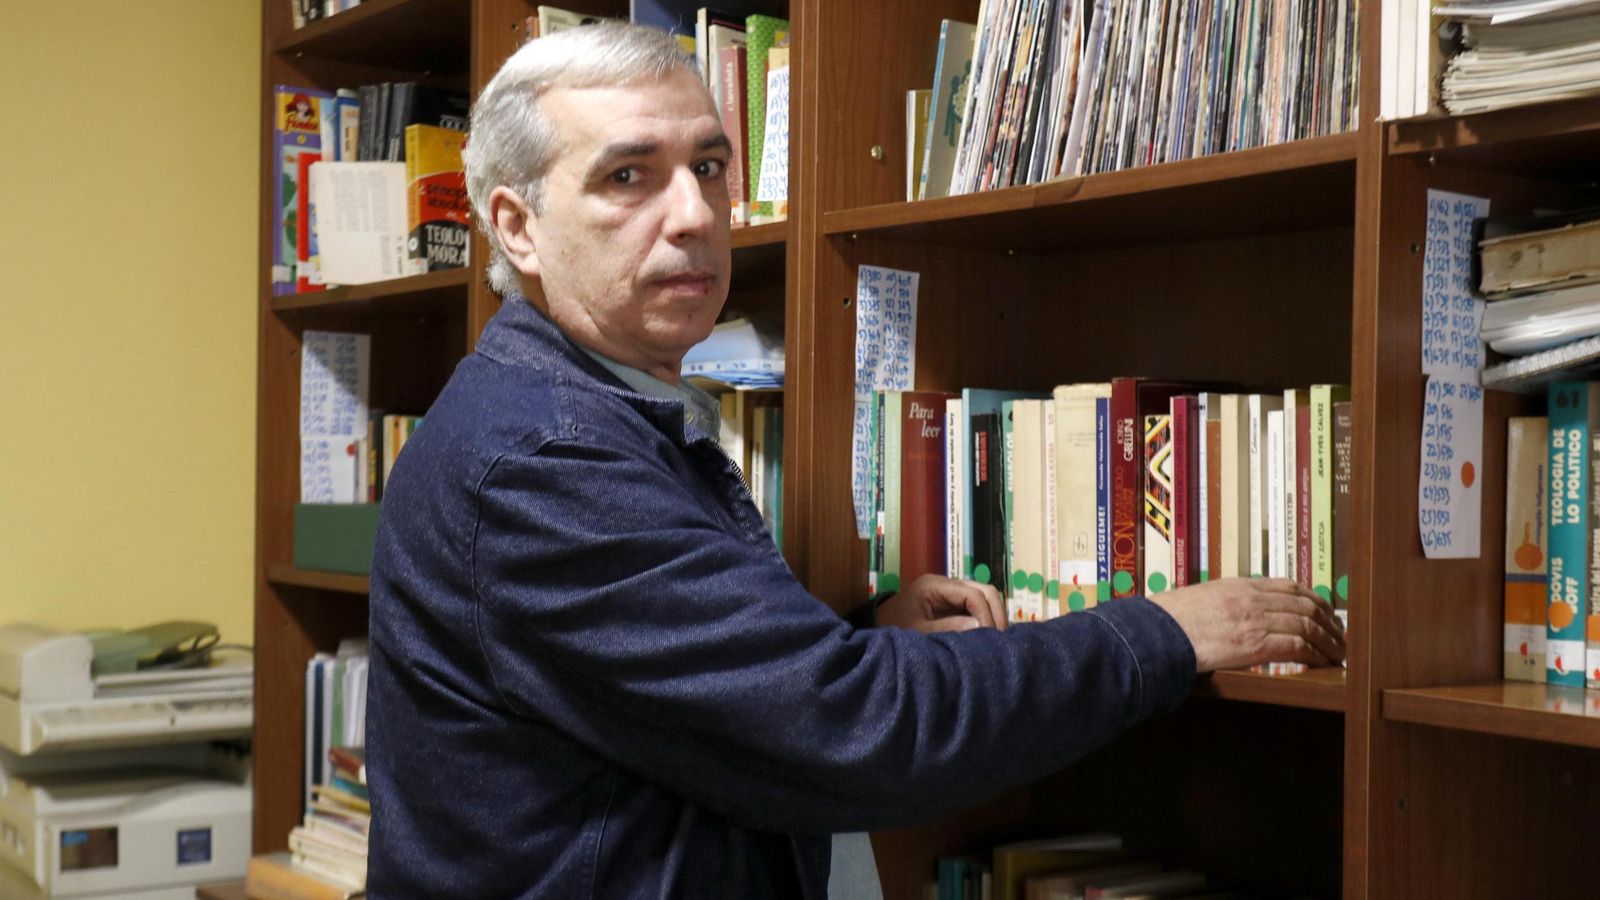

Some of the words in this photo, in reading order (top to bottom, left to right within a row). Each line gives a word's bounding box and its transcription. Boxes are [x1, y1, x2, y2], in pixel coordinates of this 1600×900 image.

[908, 401, 934, 420] Para
[921, 419, 942, 438] leer
[1552, 428, 1566, 448] DE
[1567, 429, 1582, 500] POLITICO
[1550, 452, 1565, 526] TEOLOGIA
[1566, 503, 1580, 524] LO
